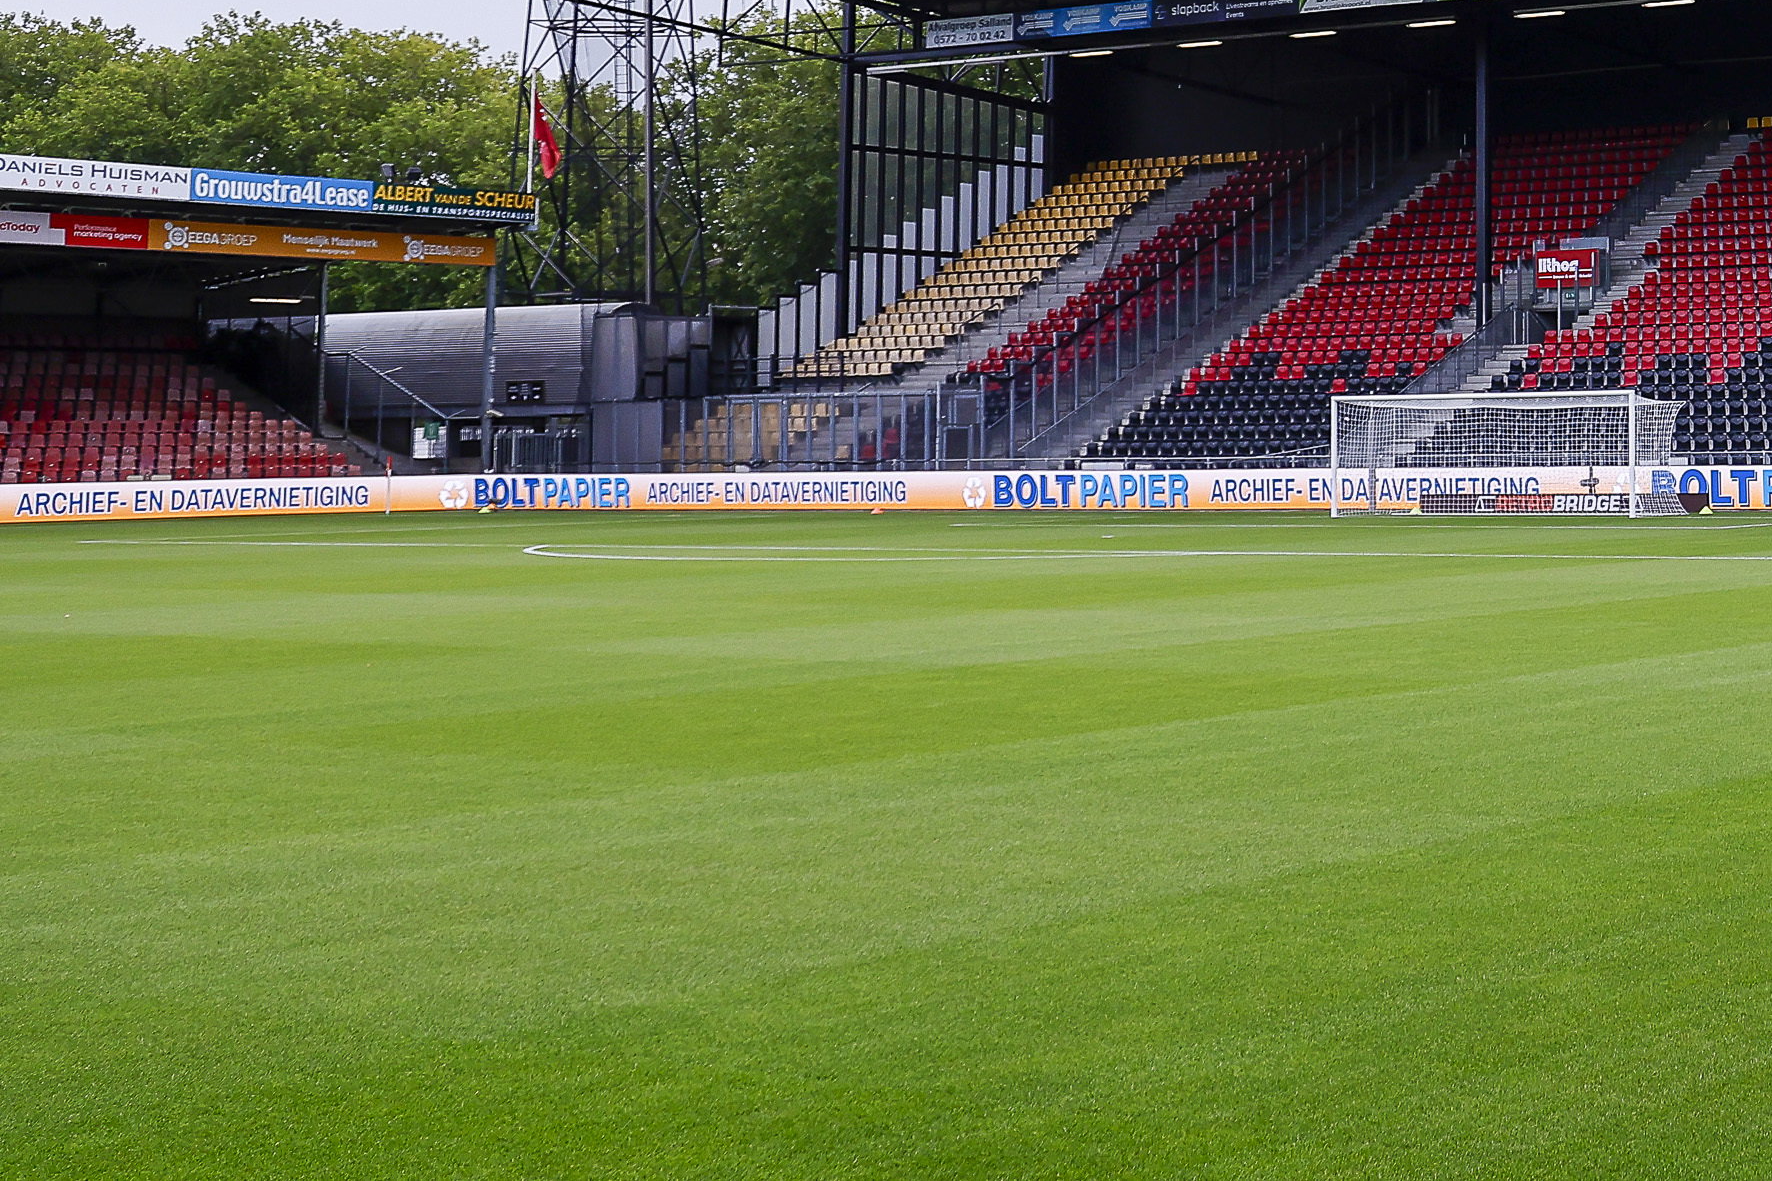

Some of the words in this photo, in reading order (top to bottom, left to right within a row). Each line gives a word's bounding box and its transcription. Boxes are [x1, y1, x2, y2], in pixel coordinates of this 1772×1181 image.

[1171, 0, 1220, 17] slapback
[928, 19, 977, 33] Afvalgroep
[978, 16, 1012, 29] Salland
[934, 34, 957, 45] 0572
[966, 32, 978, 43] 70
[993, 30, 1006, 40] 42
[91, 164, 188, 184] HUISMAN
[21, 177, 160, 195] ADVOCATEN
[195, 172, 369, 208] Grouwstra4Lease
[374, 184, 434, 203] ALBERT
[474, 191, 535, 210] SCHEUR
[372, 203, 385, 211] DE
[416, 206, 429, 214] EN
[431, 206, 535, 220] TRANSPORTSPECIALIST
[73, 231, 113, 240] marketing
[114, 232, 142, 242] agency
[473, 477, 631, 508] BOLTPAPIER
[646, 480, 720, 503] ARCHIEF-
[724, 480, 746, 503] EN
[750, 480, 907, 503] DATAVERNIETIGING
[992, 473, 1190, 508] BOLTPAPIER
[1210, 477, 1302, 502] ARCHIEF-
[1309, 477, 1333, 501] EN
[15, 490, 128, 516] ARCHIEF-
[134, 489, 164, 513] EN
[170, 485, 369, 511] DATAVERNIETIGING
